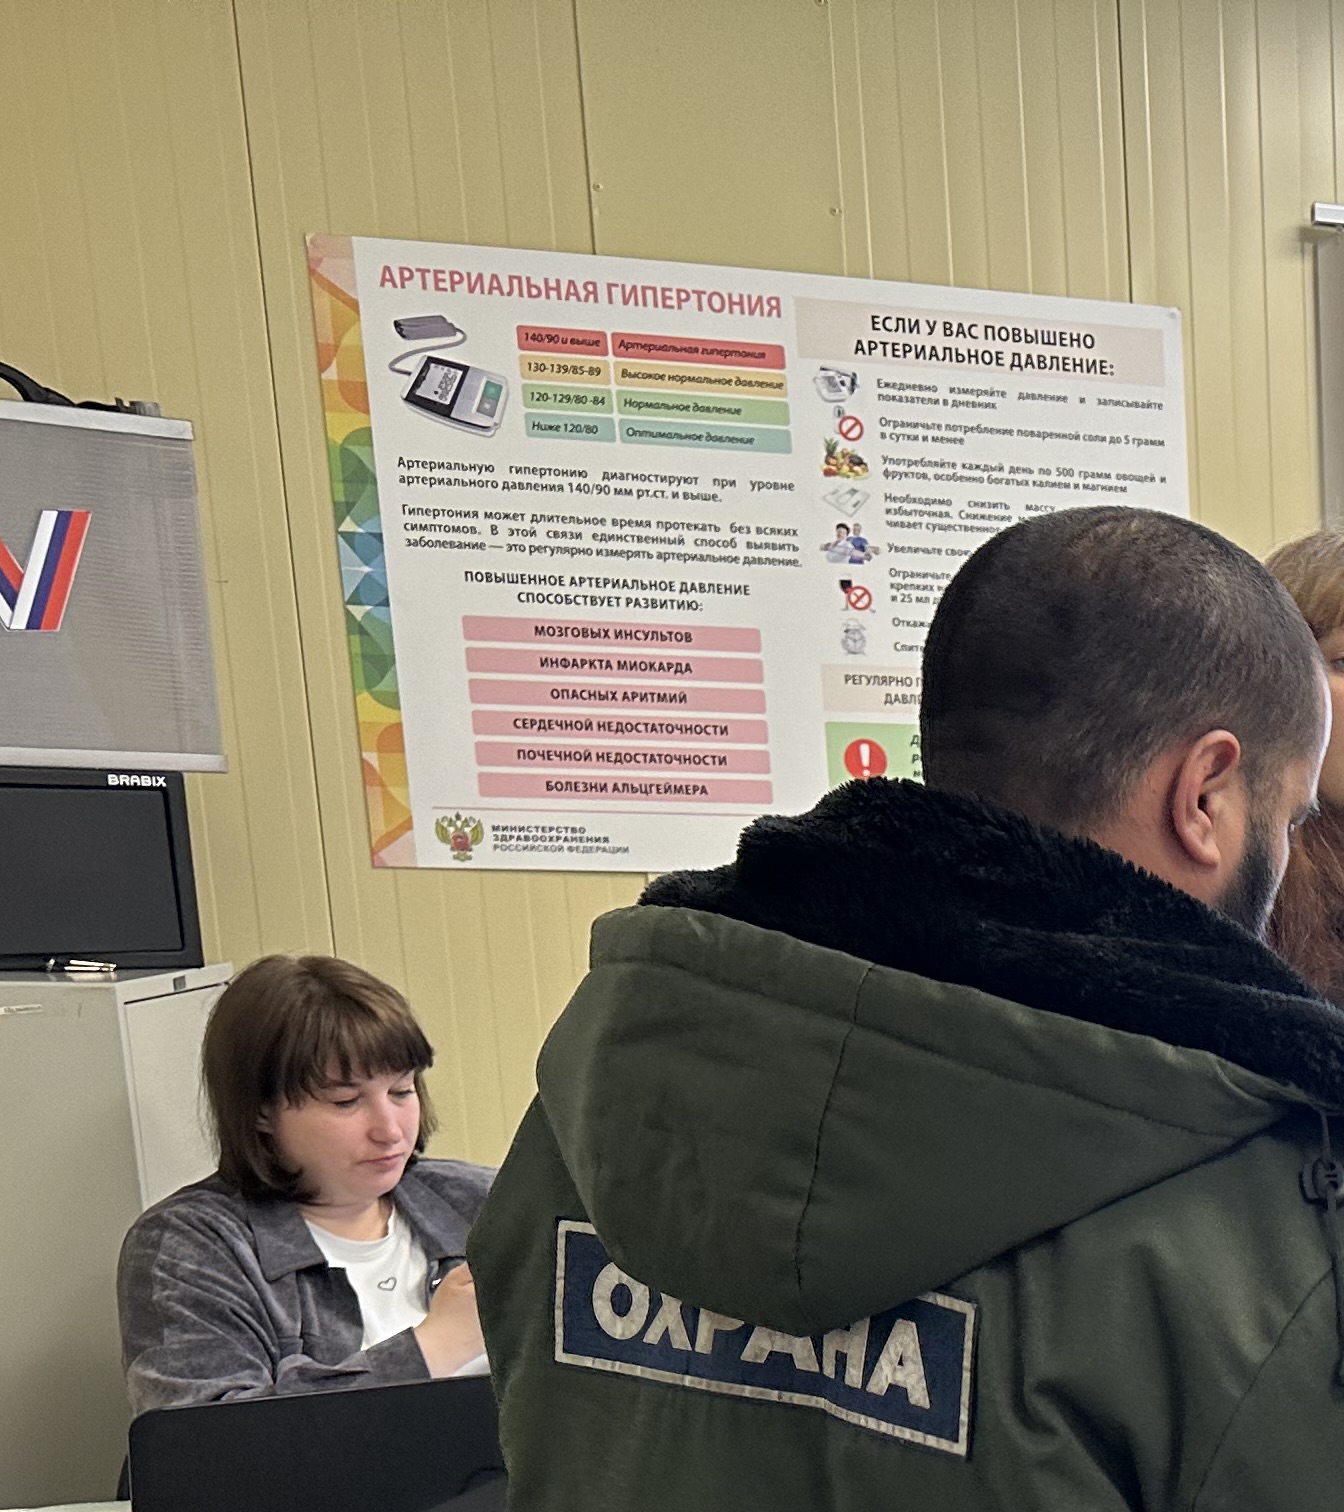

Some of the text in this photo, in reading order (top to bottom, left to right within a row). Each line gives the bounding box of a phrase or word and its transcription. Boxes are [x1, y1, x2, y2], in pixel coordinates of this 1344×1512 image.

[378, 264, 782, 318] АРТЕРИАЛЬНАЯ ГИПЕРТОНИЯ
[522, 330, 561, 344] 140/90
[559, 335, 569, 345] и
[869, 313, 1096, 350] ЕСЛИ У ВАС ПОВЫШЕНО
[616, 337, 767, 360] Артериальная гипертония
[853, 338, 1115, 376] АРТЕРИАЛЬНОЕ ДАВЛЕНИЕ:
[526, 360, 602, 377] 130-139/85-89
[619, 367, 785, 390] Высокое нормальное давление
[622, 396, 743, 416] Нормальное давление
[530, 419, 599, 435] Ниже 120/80
[624, 425, 755, 446] Оптимальное давление
[396, 455, 795, 492] Артериальную гипертонию диагностируют при уровне
[397, 473, 499, 490] артериального
[500, 479, 565, 493] давления
[566, 481, 611, 496] 140/90
[612, 486, 634, 497] мм
[670, 490, 680, 500] и
[681, 490, 723, 503] выше.
[400, 502, 799, 537] Гипертония может длительное время протекать без всяких
[402, 521, 800, 553] симптомов. В этой связи единственный способ выявить
[404, 534, 803, 568] заболевание это регулярно измерять артериальное давление.
[463, 569, 750, 596] ПОВЫШЕННОЕ АРТЕРИАЛЬНОЕ ДАВЛЕНИЕ
[515, 590, 703, 612] СПОСОБСТВУЕТ РАЗВИТИЮ:
[533, 624, 693, 644] МОЗГОВЫХ ИНСУЛЬТОВ
[538, 655, 693, 676] ИНФАРКТА МИОКАРДА
[548, 686, 688, 705] ОПАСНЫХ АРИТМИЙ
[511, 716, 729, 737] СЕРДЕЧНОЙ НЕДОСТАТОЧНОСТИ
[515, 747, 728, 766] ПОЧЕЧНОЙ НЕДОСТАТОЧНОСТИ
[107, 773, 167, 788] BRABIX
[544, 779, 709, 797] БОЛЕЗНИ АЛЬЦГЕЙМЕРА
[490, 823, 587, 835] МИНИСТЕРСТВО
[491, 832, 610, 844] ЗДРАВООХРАНЕНИЯ
